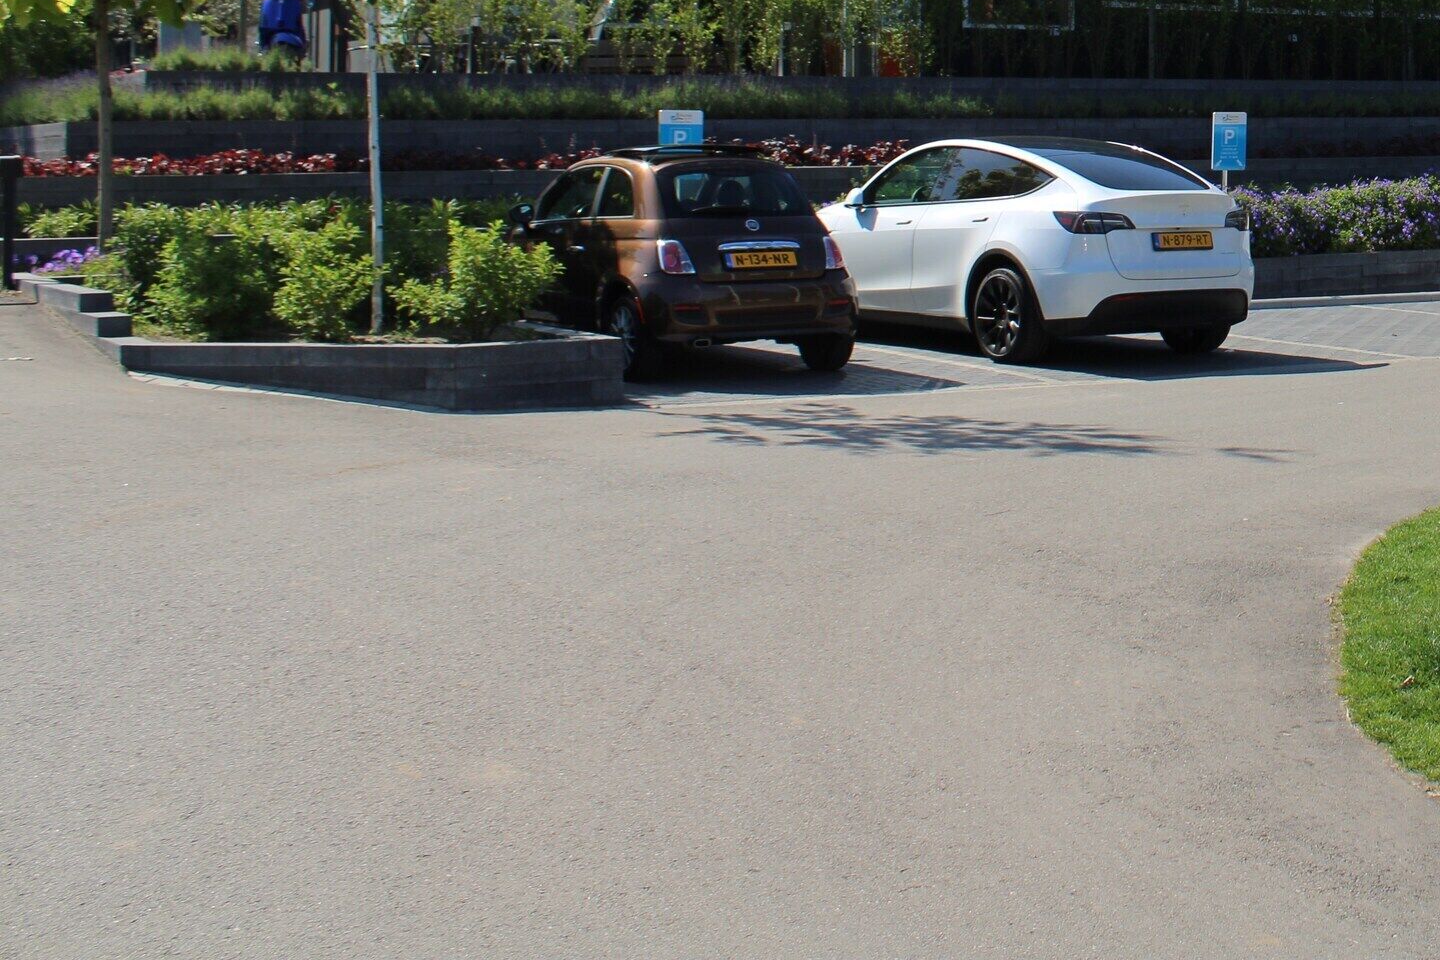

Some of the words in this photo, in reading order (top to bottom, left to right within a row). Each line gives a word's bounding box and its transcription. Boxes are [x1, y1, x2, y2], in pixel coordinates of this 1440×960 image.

[1224, 129, 1235, 144] P
[1162, 234, 1209, 246] N-879-RT
[734, 253, 791, 266] N-134-NR
